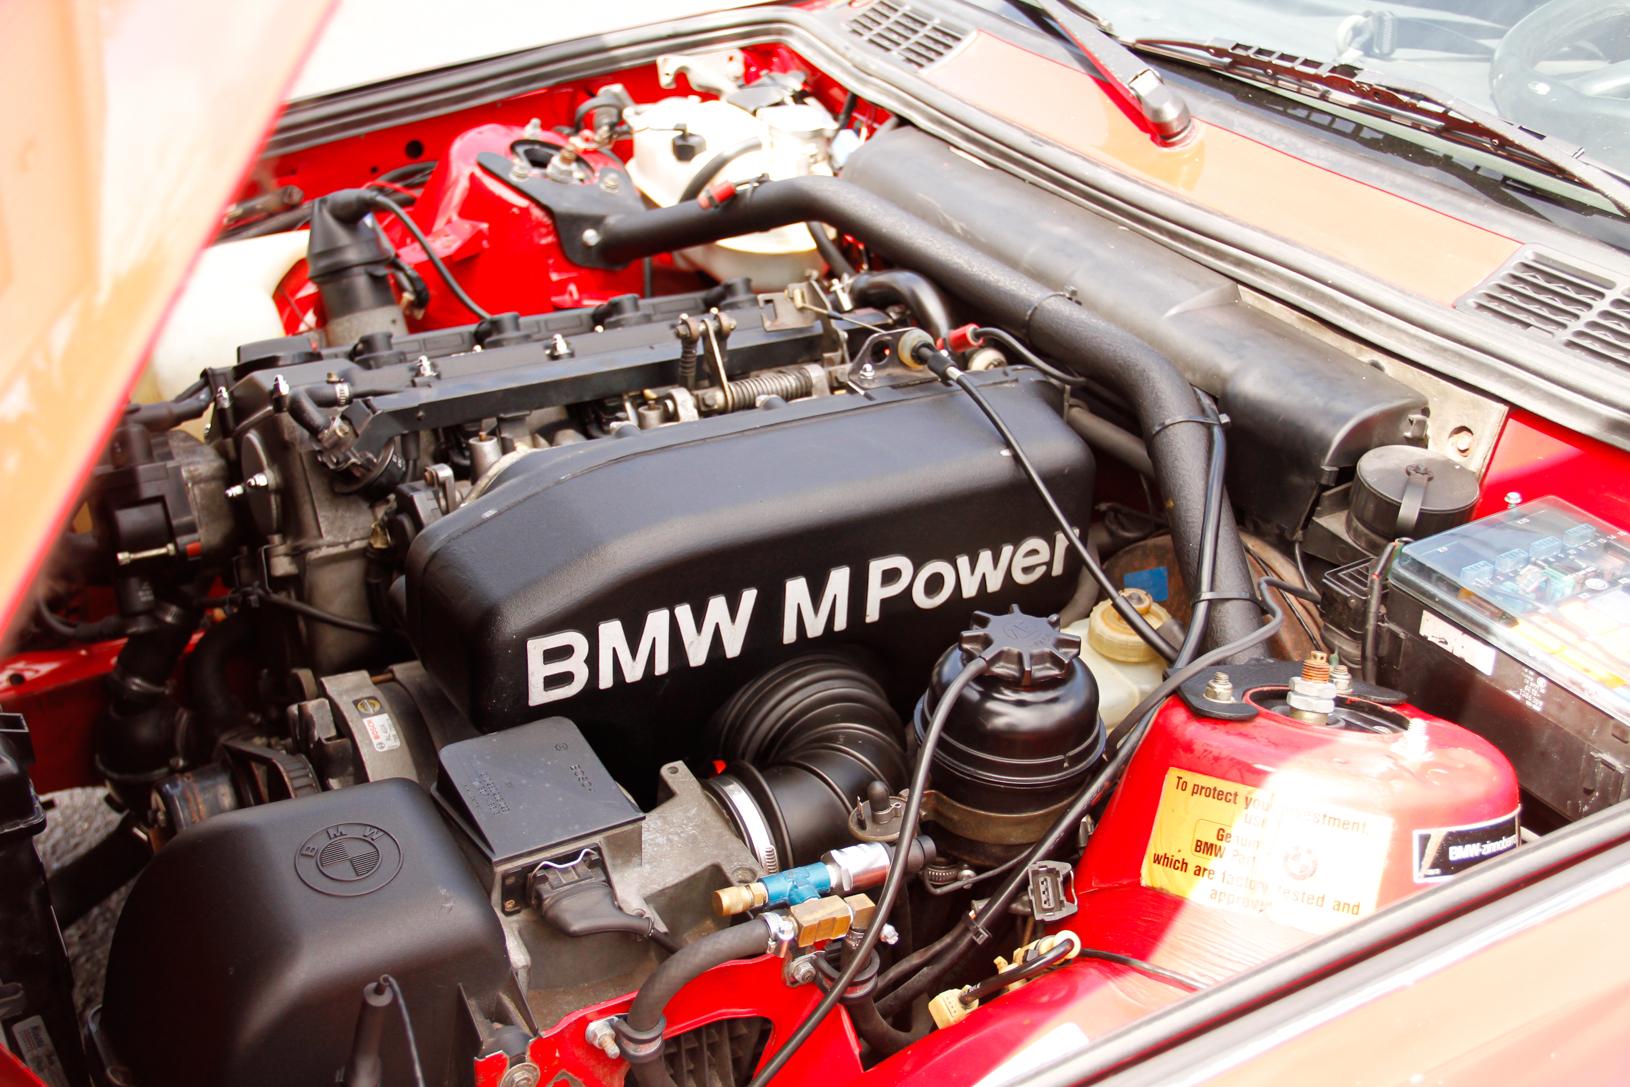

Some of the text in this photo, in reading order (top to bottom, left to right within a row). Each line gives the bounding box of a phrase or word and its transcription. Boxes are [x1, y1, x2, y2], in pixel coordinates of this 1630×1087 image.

[526, 527, 1080, 707] BMW M Power
[1175, 776, 1188, 792] To
[1191, 783, 1239, 804] protect
[300, 825, 385, 858] BMW
[1194, 839, 1226, 858] BMW
[1152, 852, 1189, 873] which
[1193, 864, 1215, 880] are
[1332, 900, 1361, 916] and
